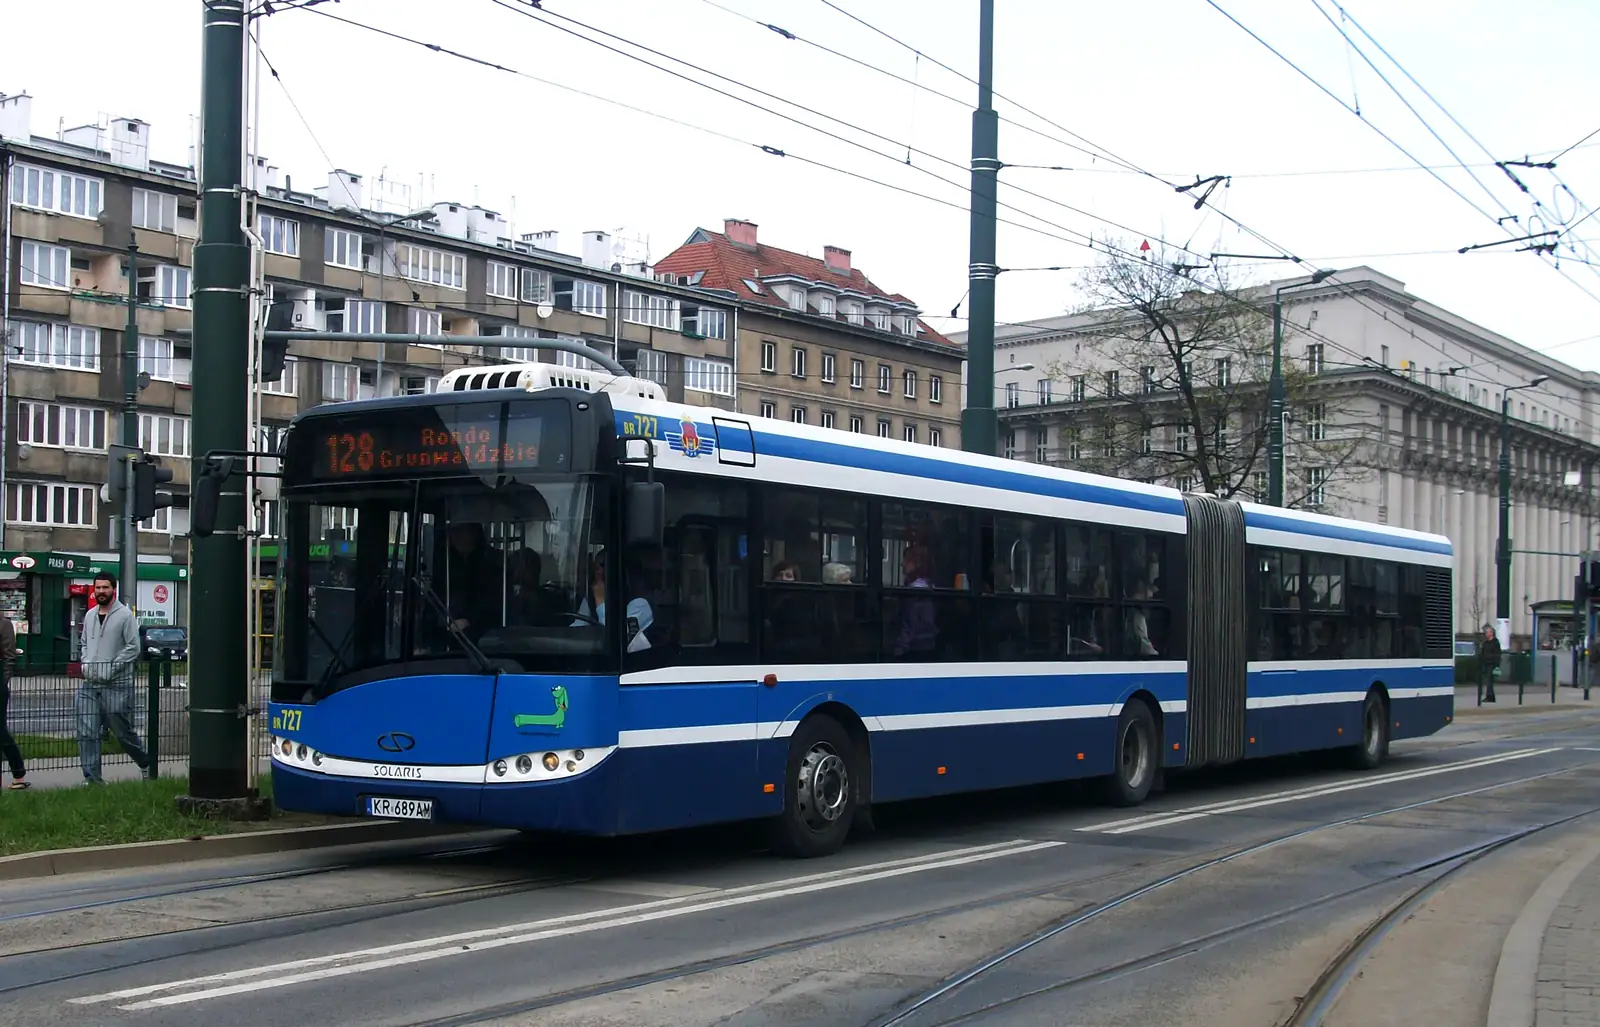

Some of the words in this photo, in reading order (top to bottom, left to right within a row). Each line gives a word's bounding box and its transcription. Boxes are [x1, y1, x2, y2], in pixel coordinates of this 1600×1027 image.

[420, 425, 491, 447] Rondo
[623, 421, 635, 435] BR
[634, 415, 658, 438] 727
[326, 431, 375, 474] 128
[48, 558, 65, 568] PRASA
[273, 716, 281, 728] BR
[281, 709, 302, 731] 727
[373, 765, 422, 778] SOLARIS
[373, 799, 391, 815] KR
